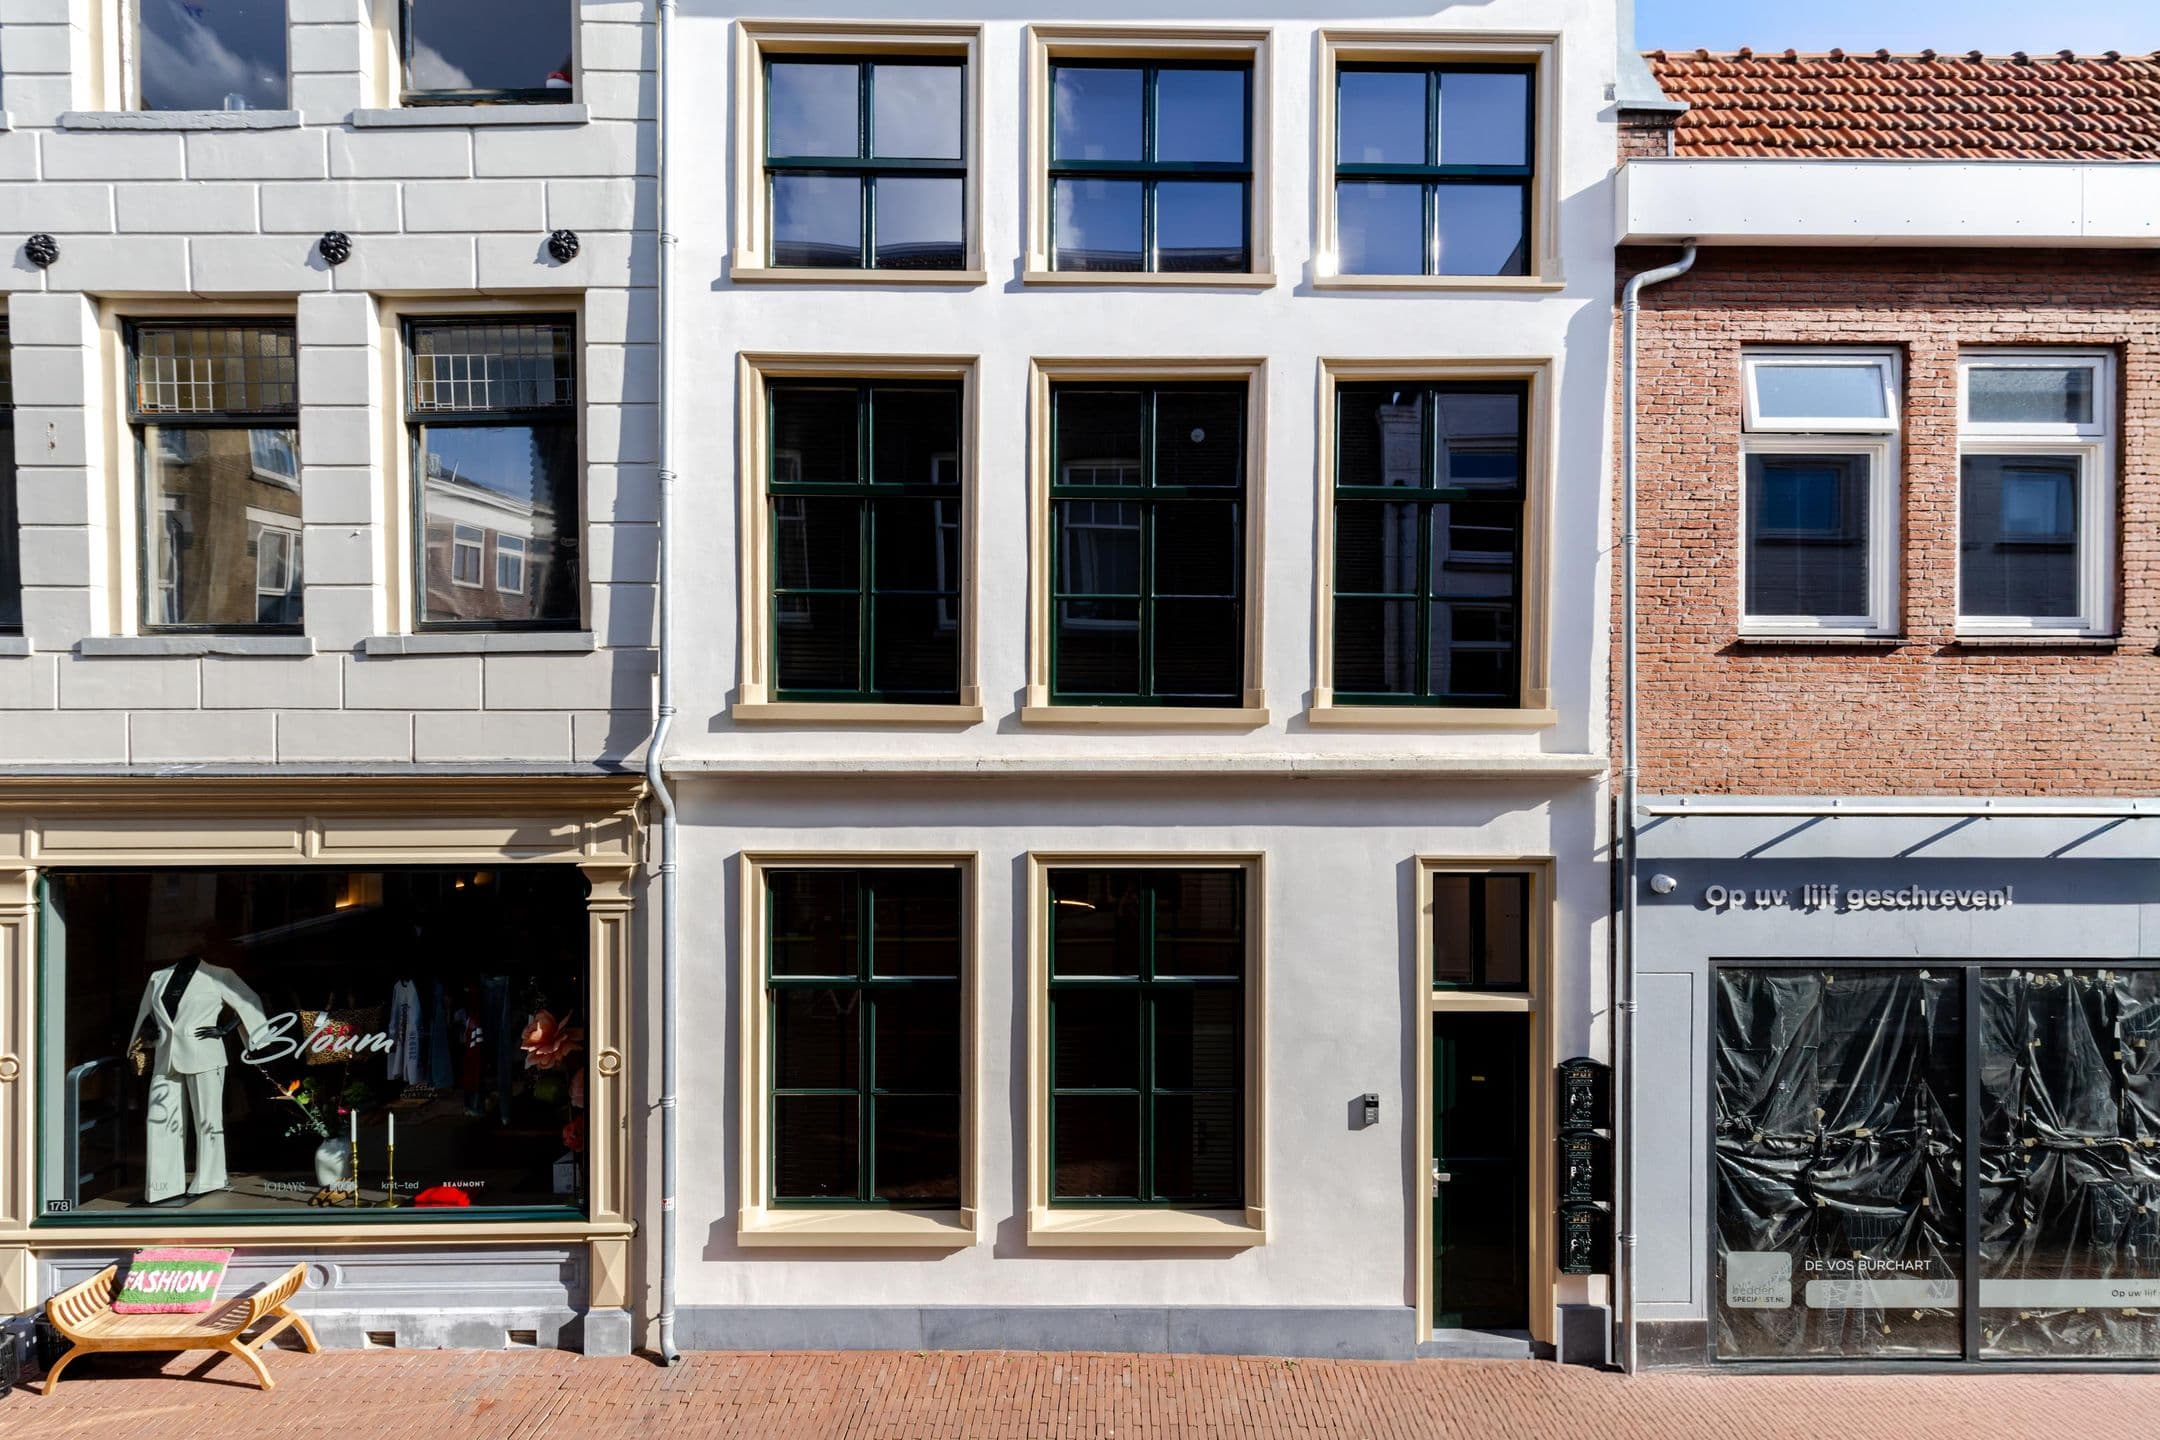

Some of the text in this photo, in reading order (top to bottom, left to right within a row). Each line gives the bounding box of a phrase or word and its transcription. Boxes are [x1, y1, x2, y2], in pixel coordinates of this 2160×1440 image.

[1705, 884, 1747, 910] Op
[1803, 883, 1839, 910] lijf
[1846, 884, 2014, 910] geschreven!
[442, 1180, 485, 1188] BEAUMONT
[49, 1201, 69, 1211] 178
[1805, 1260, 1932, 1271] DE VOS BURCHART
[123, 1269, 214, 1293] FASHION
[2111, 1289, 2126, 1298] Op
